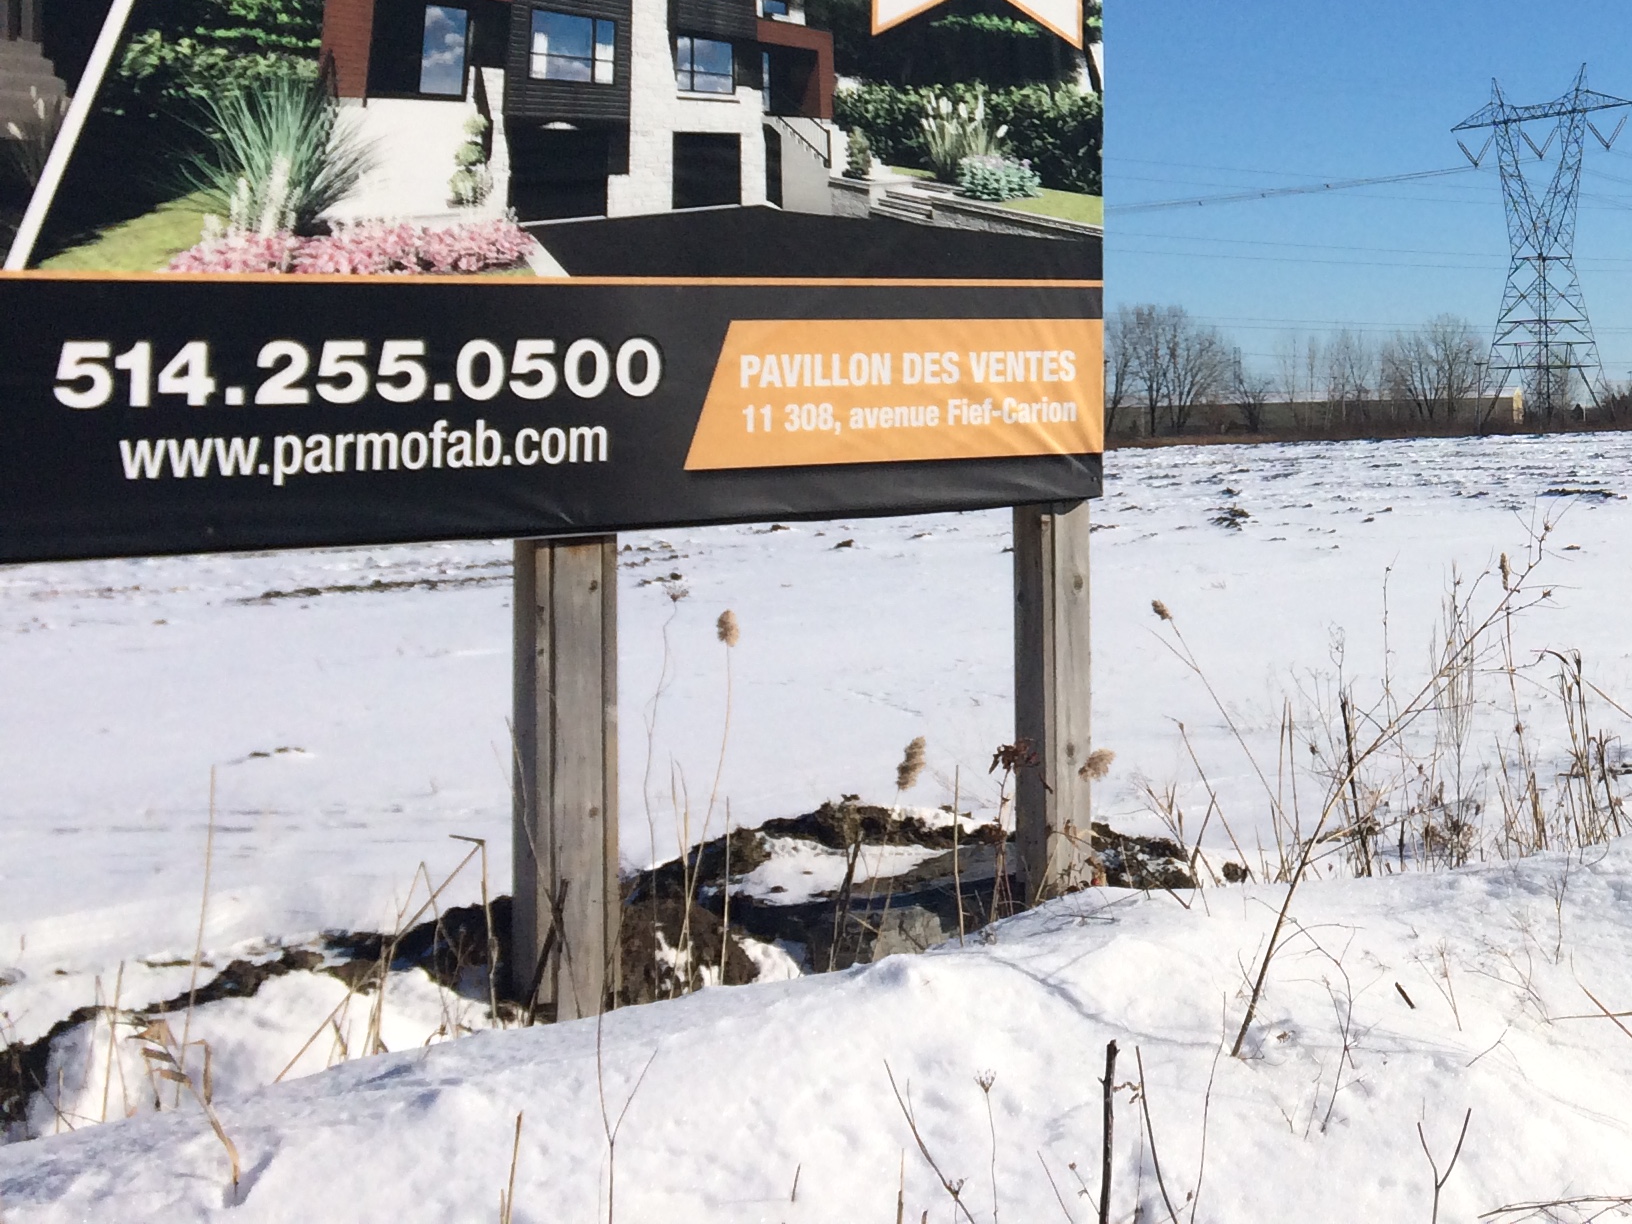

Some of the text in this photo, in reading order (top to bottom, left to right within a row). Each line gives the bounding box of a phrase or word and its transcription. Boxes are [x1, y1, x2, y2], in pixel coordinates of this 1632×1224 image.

[53, 337, 662, 410] 514.255.0500
[739, 350, 1077, 388] PAVILLON DES VENTES
[742, 396, 1077, 436] 11 308, avenue Fief-Carion
[119, 419, 609, 486] www.parmofab.com
